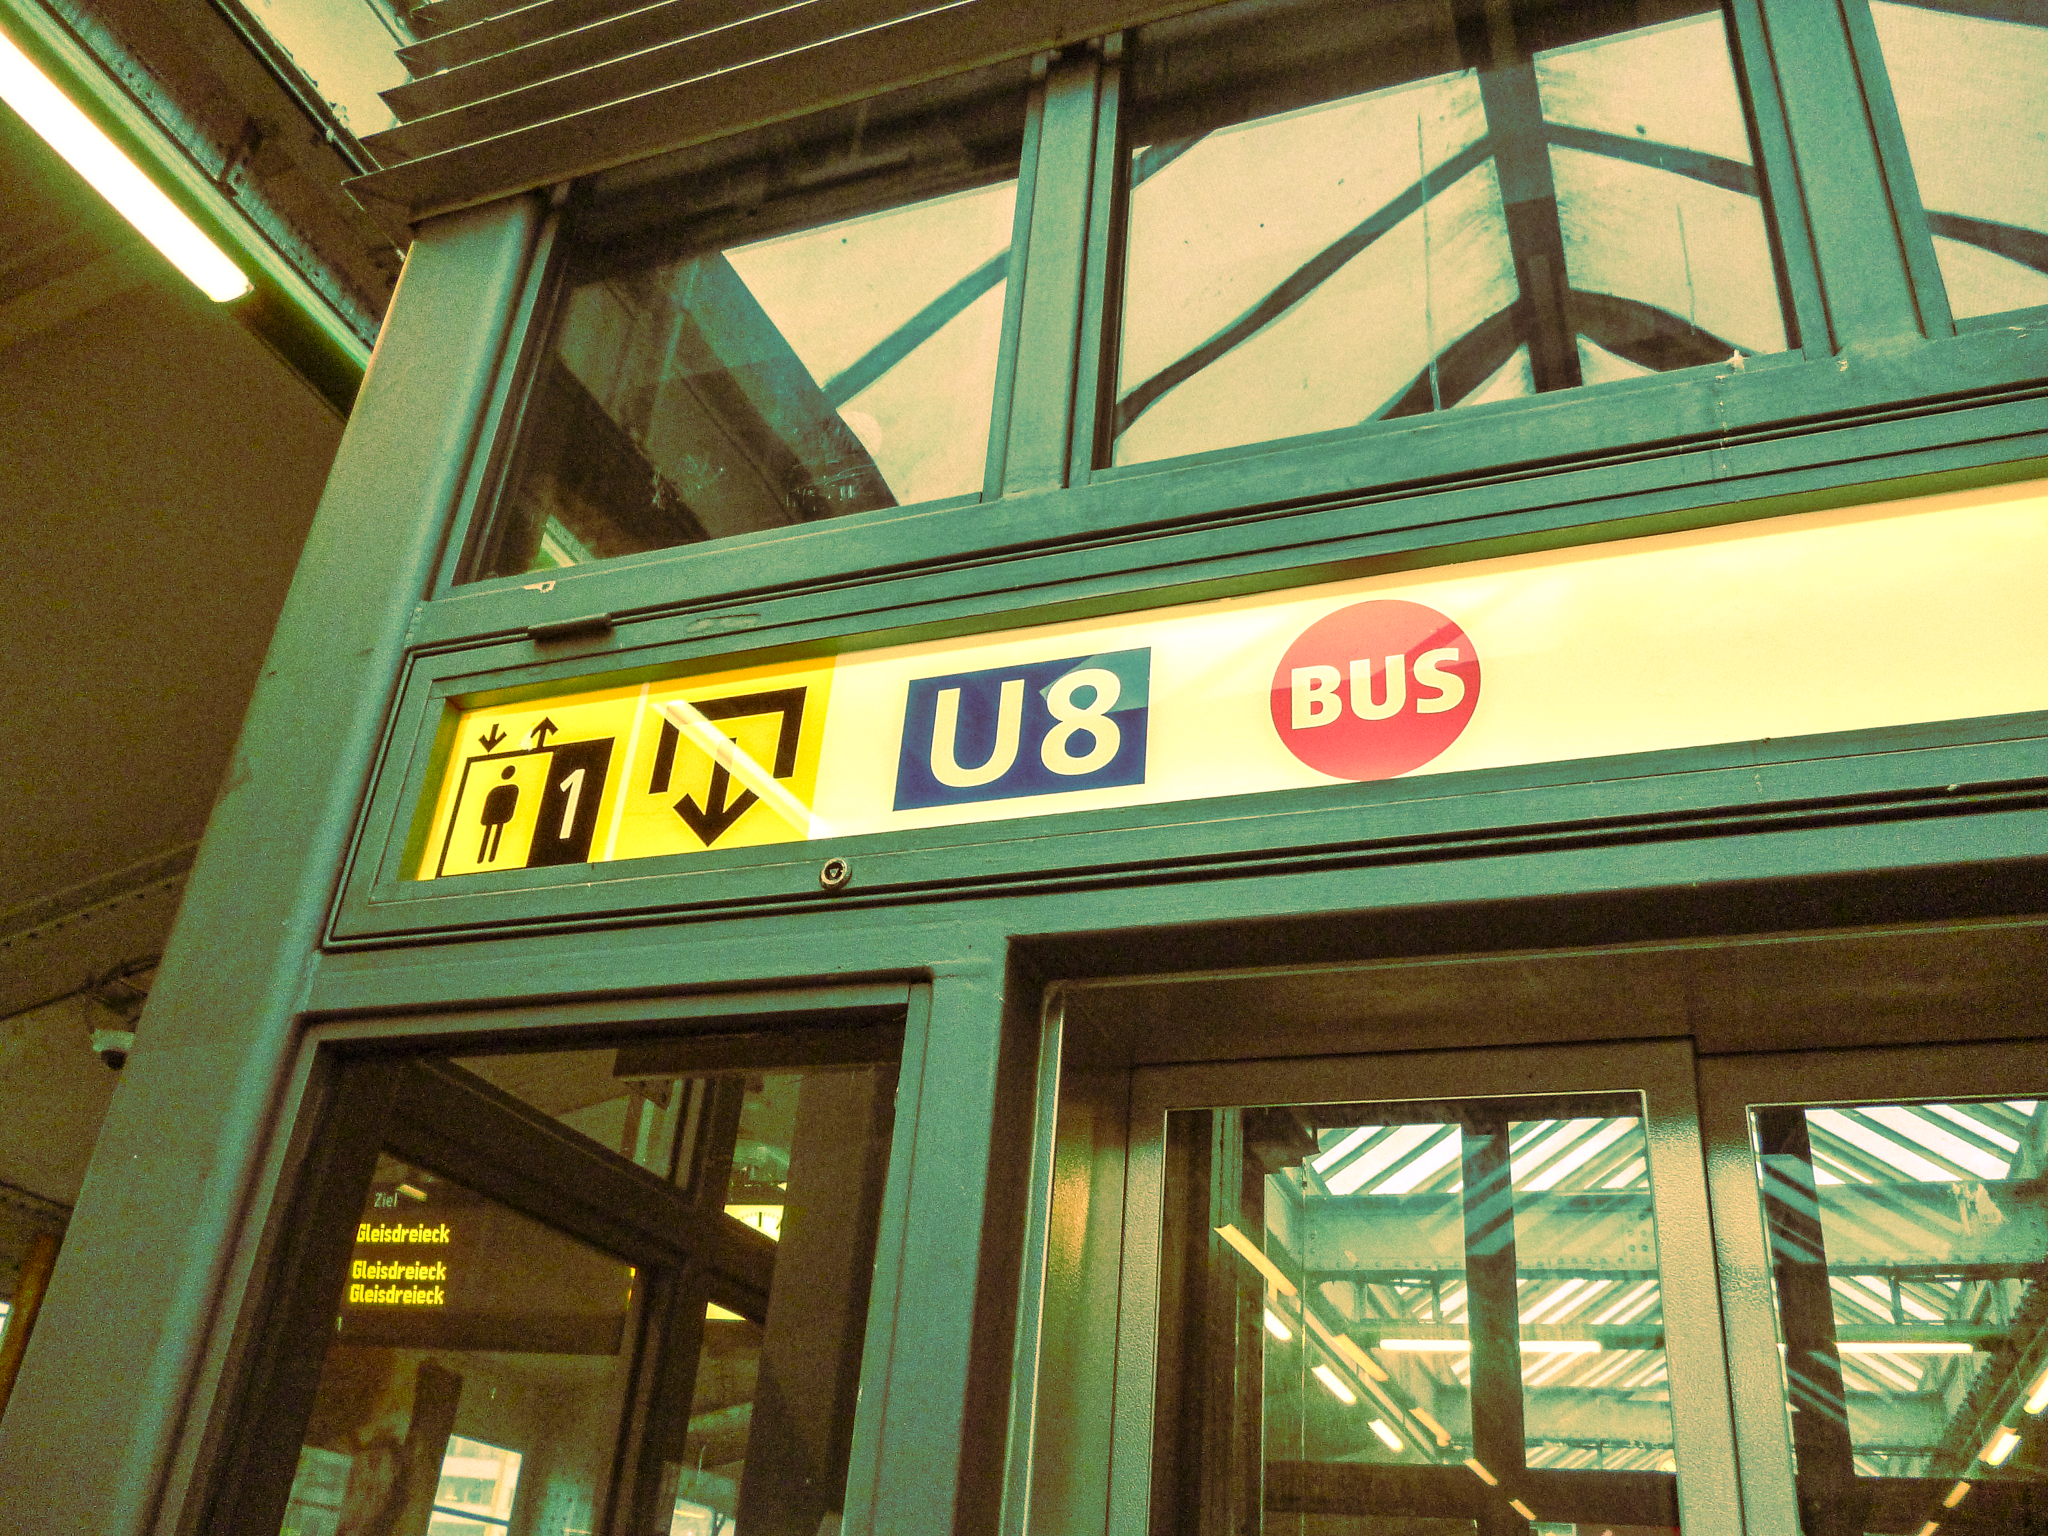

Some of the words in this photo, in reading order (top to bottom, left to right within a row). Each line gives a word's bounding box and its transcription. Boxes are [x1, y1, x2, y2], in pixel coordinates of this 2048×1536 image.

[1291, 647, 1466, 730] BUS
[930, 668, 1121, 788] U8
[559, 768, 586, 840] 1
[374, 1192, 398, 1207] Ziel
[356, 1223, 450, 1243] Gleisdreieck
[352, 1260, 446, 1280] Gleisdreieck
[350, 1284, 444, 1304] Gleisdreieck
